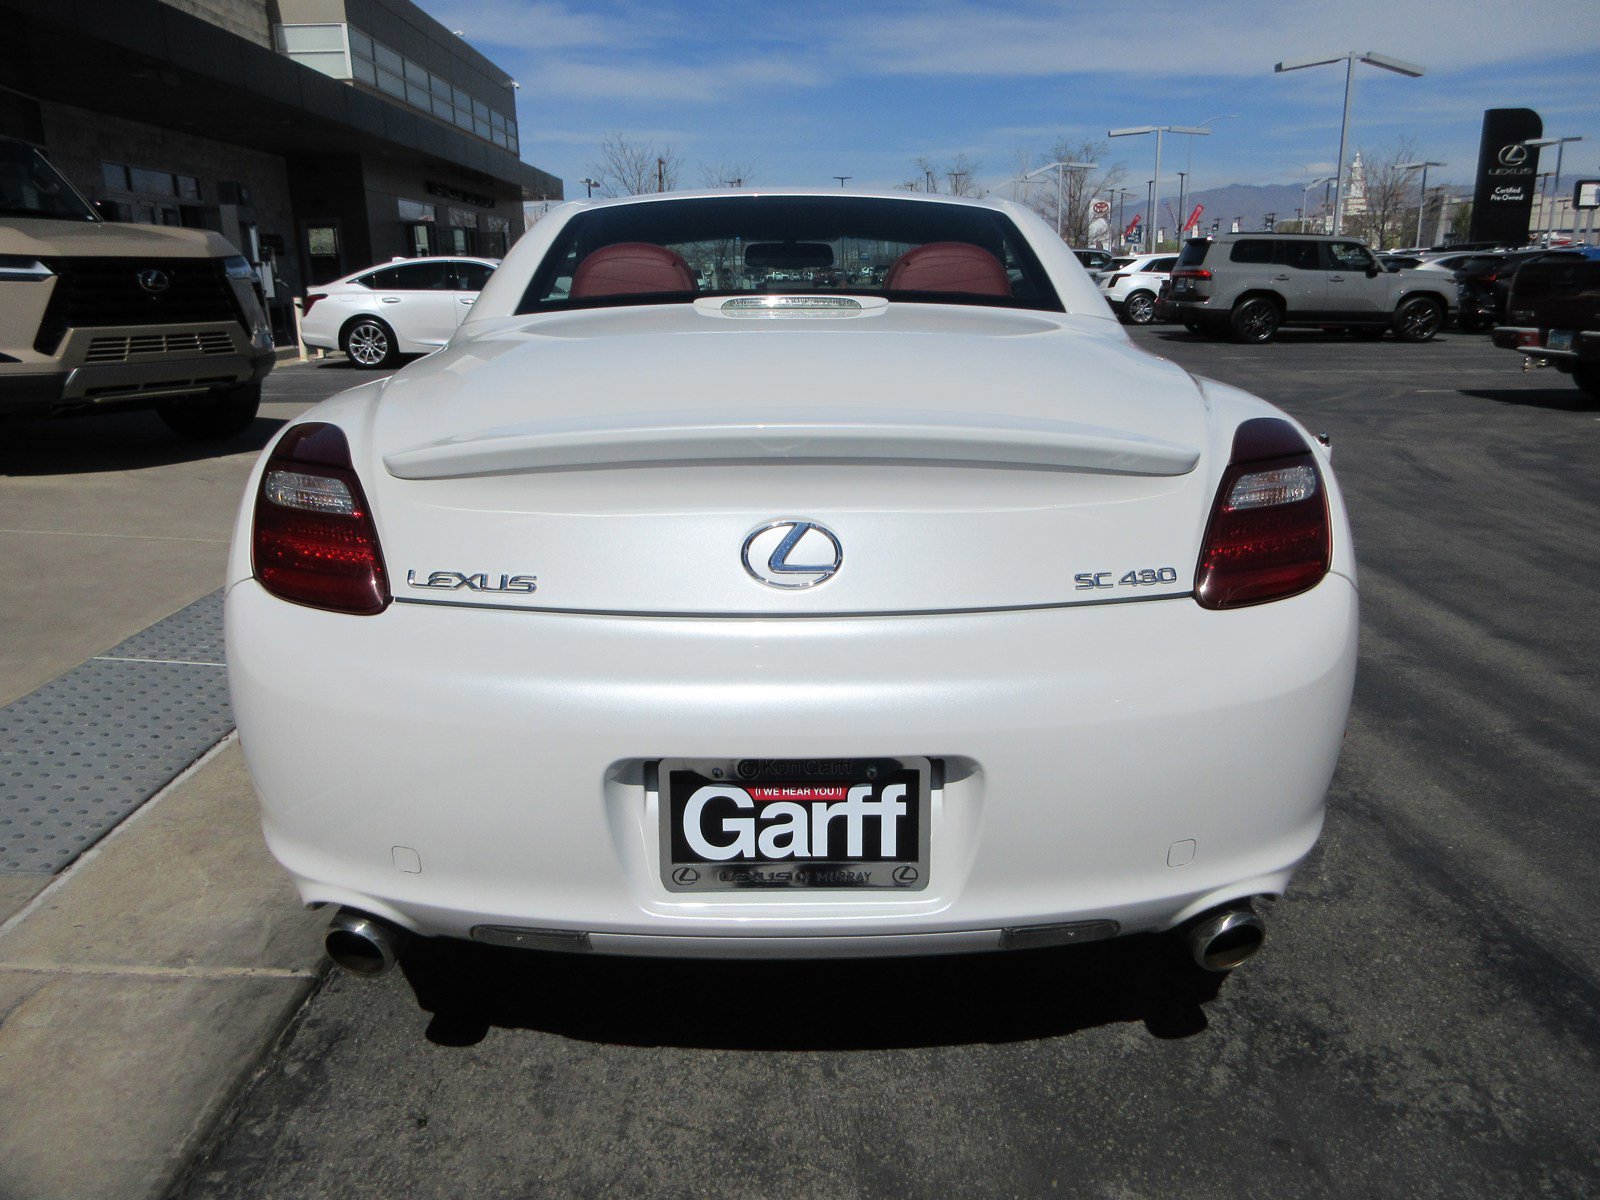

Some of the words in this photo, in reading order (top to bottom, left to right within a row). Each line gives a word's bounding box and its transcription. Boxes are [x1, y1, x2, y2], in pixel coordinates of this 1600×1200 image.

[1488, 168, 1533, 176] LEXUS
[1495, 186, 1521, 194] Certified
[407, 569, 537, 594] LEXUS
[1074, 571, 1114, 591] SC
[1118, 567, 1177, 587] 430
[763, 787, 780, 796] WE
[782, 787, 811, 796] HEAR
[814, 787, 835, 796] YOU
[682, 783, 907, 861] Garff
[816, 871, 872, 883] MURRAY
